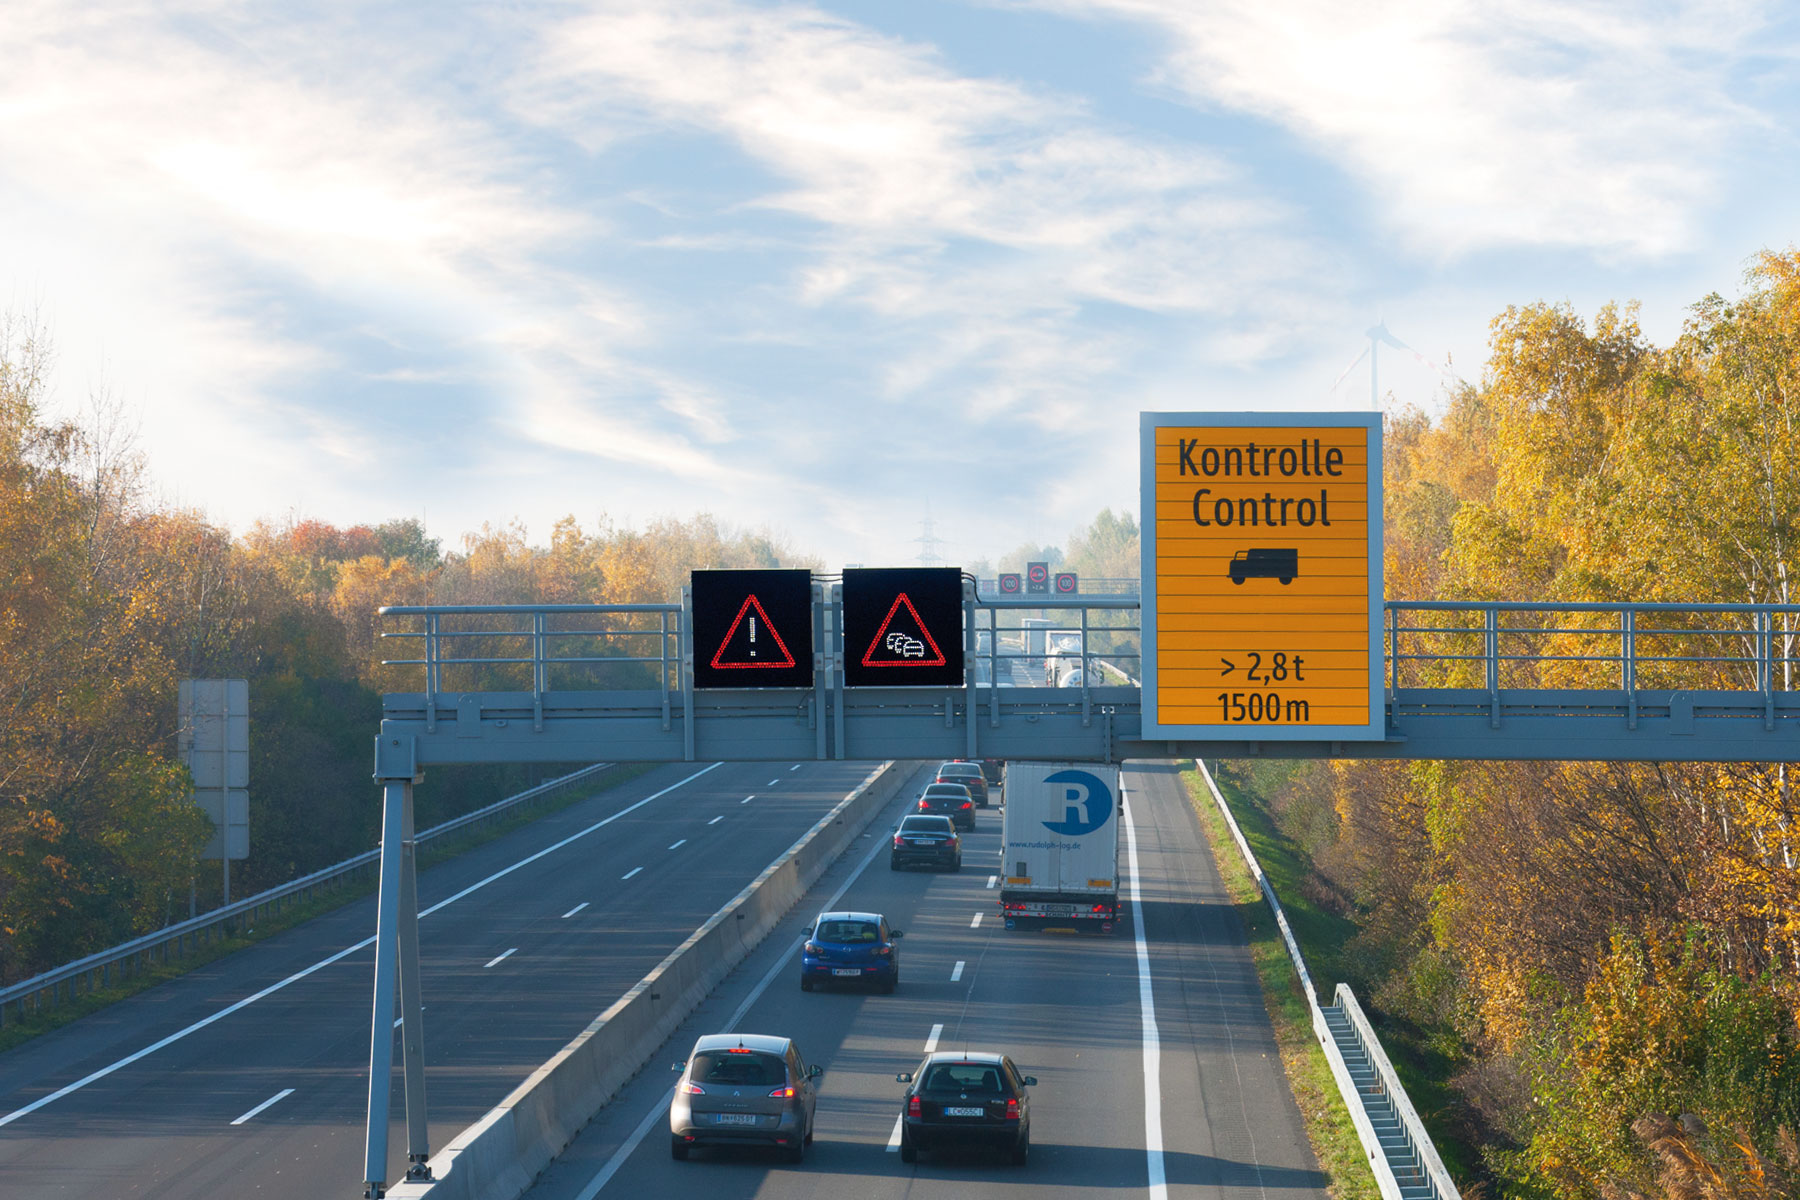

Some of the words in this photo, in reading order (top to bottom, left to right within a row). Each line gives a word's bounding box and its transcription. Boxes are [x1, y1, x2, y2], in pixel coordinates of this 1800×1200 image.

[1179, 439, 1343, 477] Kontrolle
[1193, 488, 1331, 527] Control
[1009, 841, 1081, 851] www.rudolph-log.de
